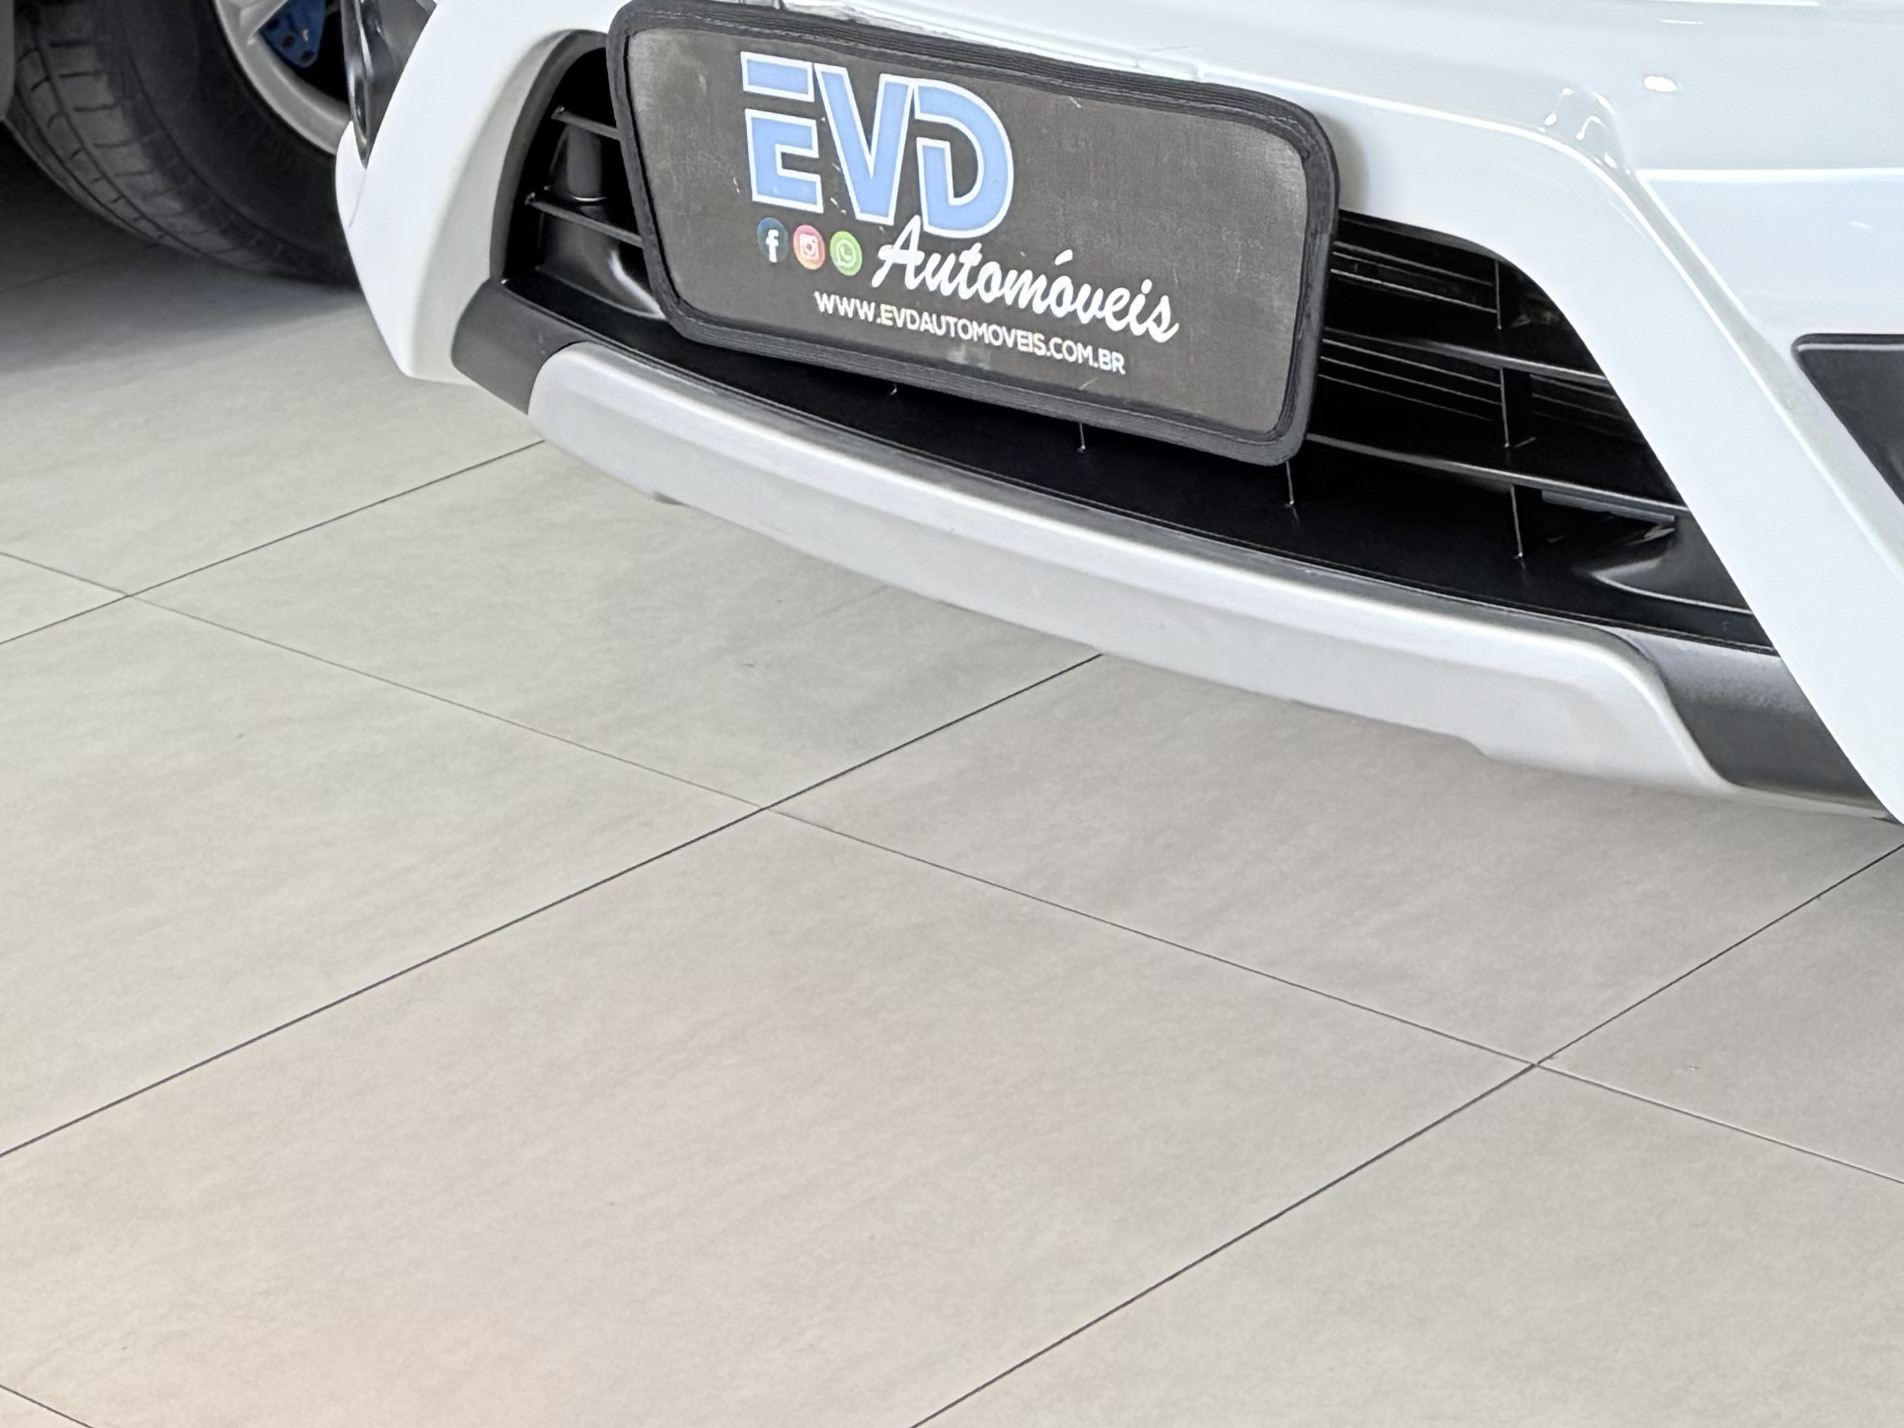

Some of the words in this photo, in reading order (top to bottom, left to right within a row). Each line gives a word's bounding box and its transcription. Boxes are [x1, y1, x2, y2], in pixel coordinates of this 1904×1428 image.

[740, 50, 1014, 239] EVD
[813, 290, 1127, 376] WWW.EVDAUTOMOVEIS.COM.BR
[871, 215, 1180, 344] Automóveis
